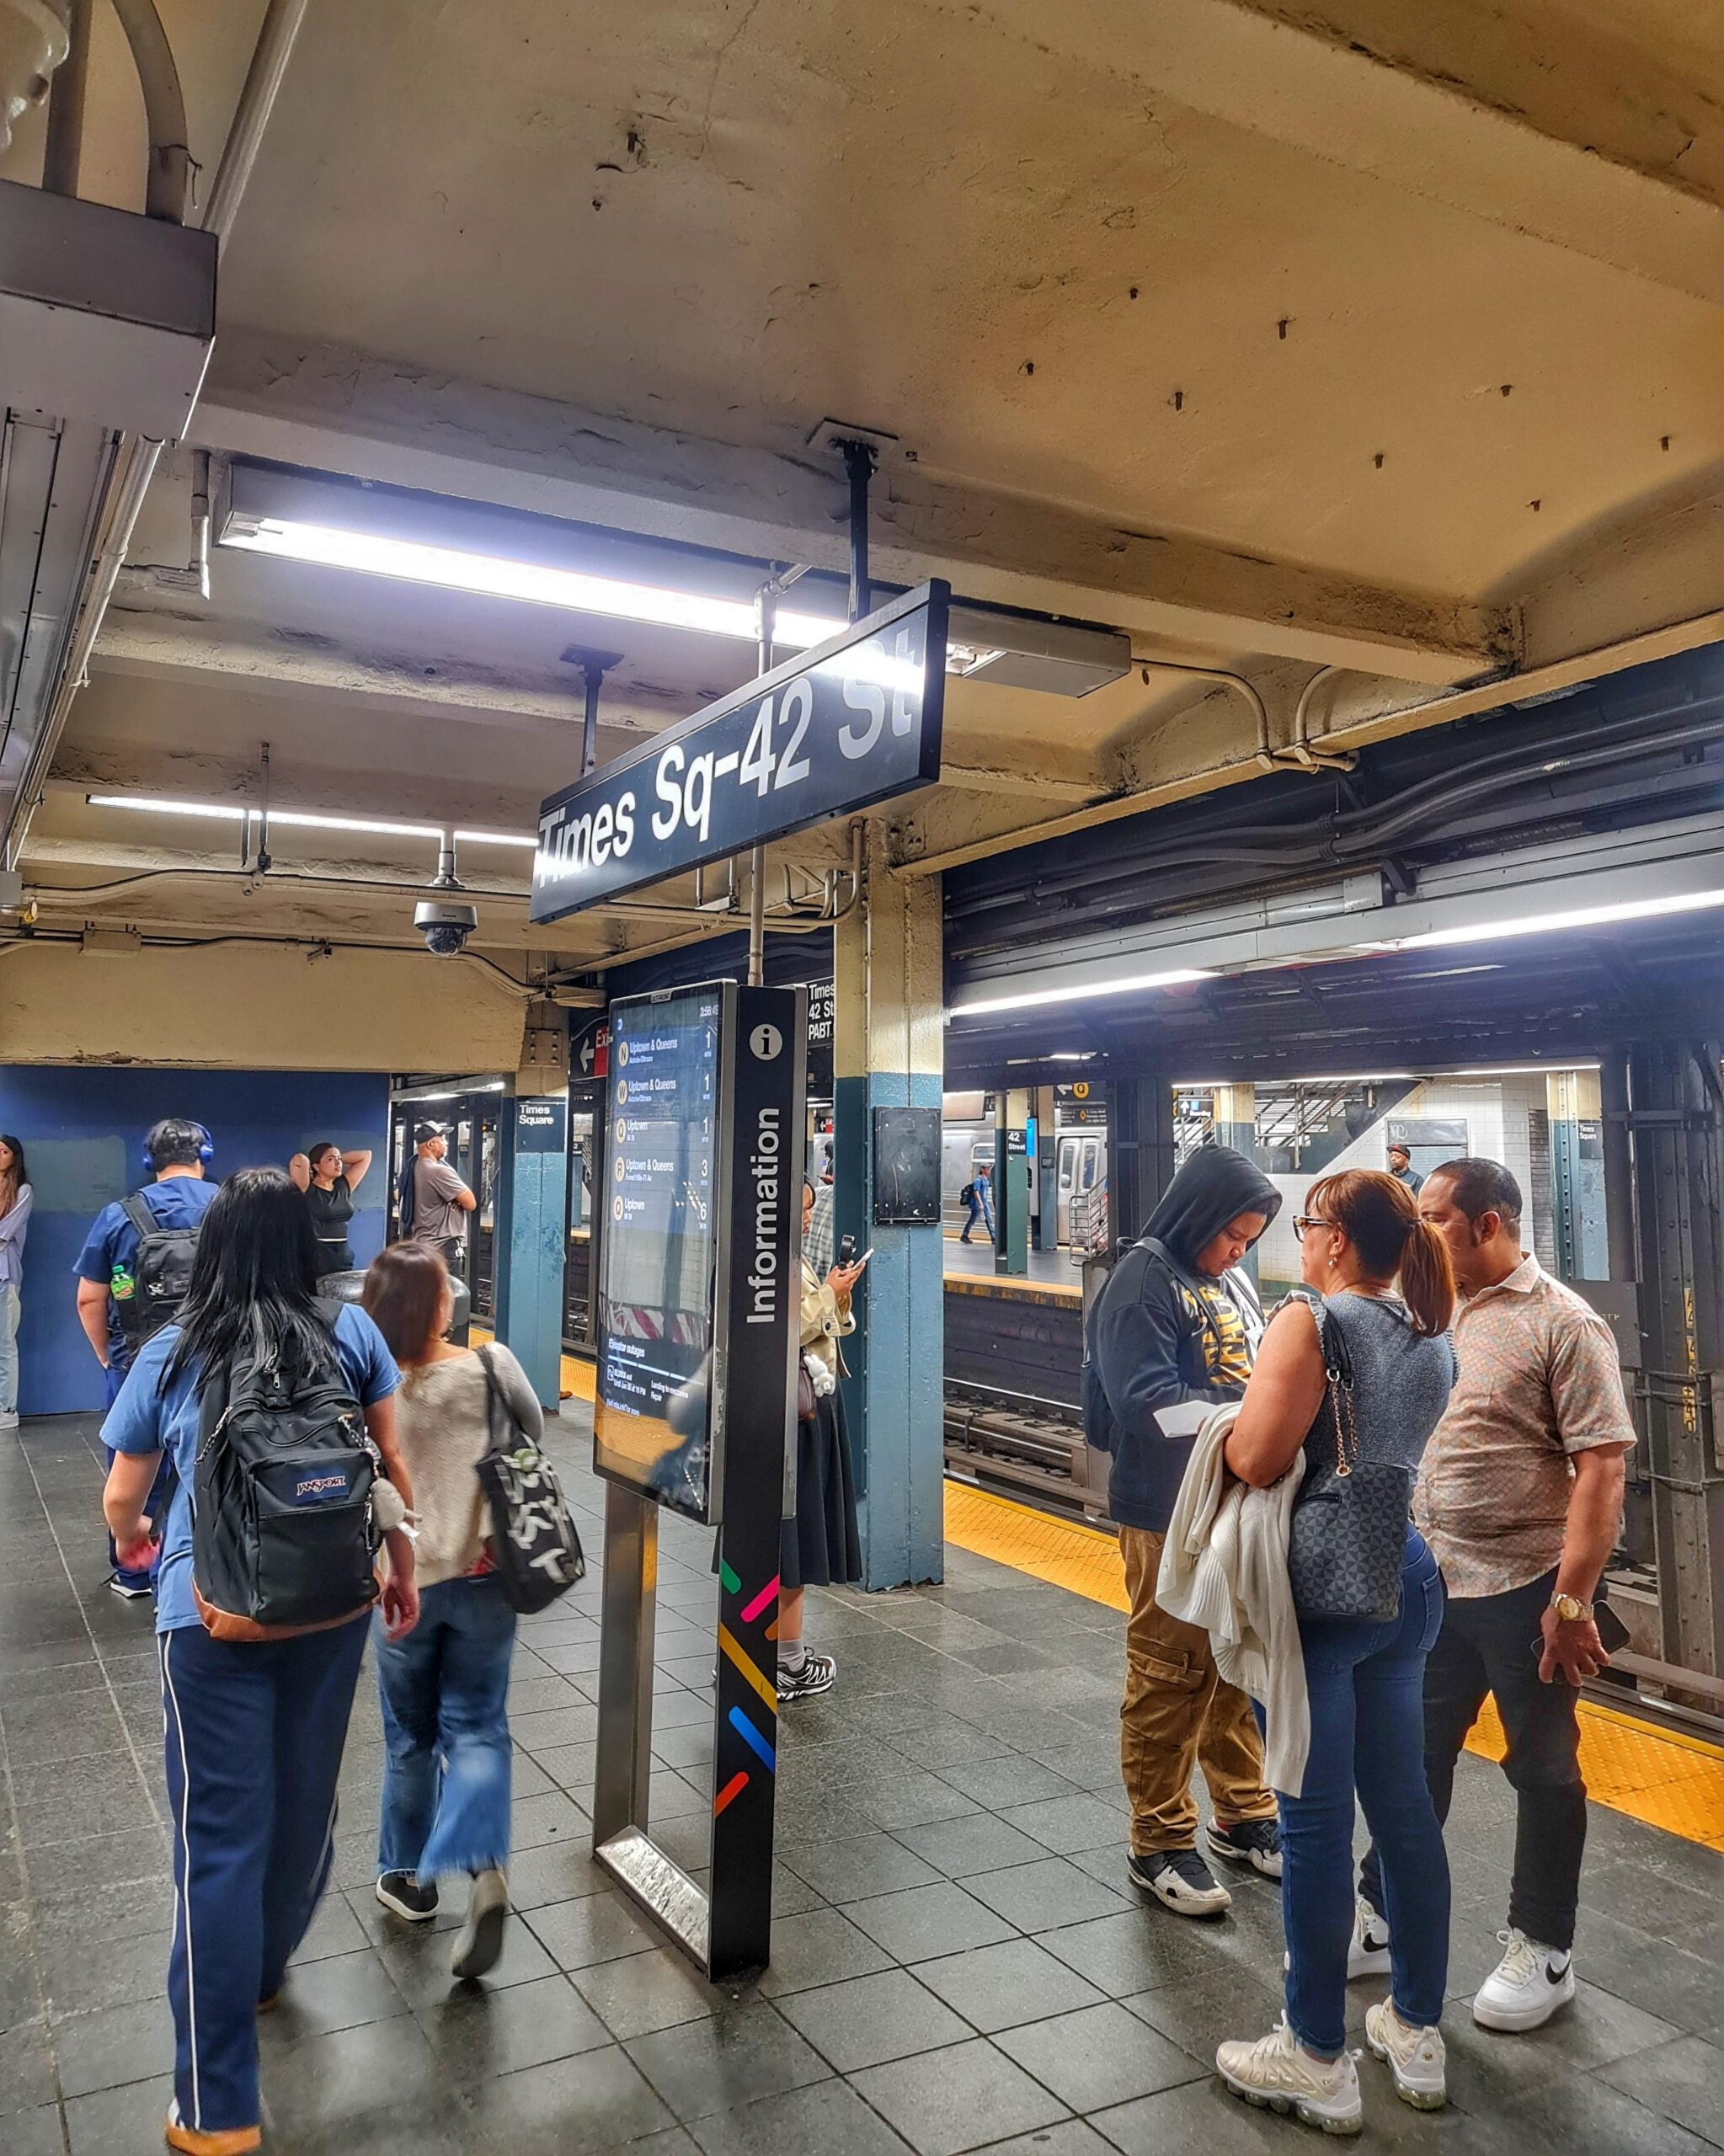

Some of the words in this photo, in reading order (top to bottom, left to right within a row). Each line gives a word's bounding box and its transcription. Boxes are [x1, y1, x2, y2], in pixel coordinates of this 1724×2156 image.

[538, 791, 636, 889] Times
[651, 677, 813, 842] Sq-42
[838, 627, 915, 760] St
[809, 984, 834, 1001] Times
[809, 1002, 821, 1020] 42
[595, 1027, 609, 1048] Exi
[809, 1021, 832, 1041] PABT
[629, 1042, 650, 1055] Uptown
[651, 1039, 656, 1051] &
[656, 1038, 677, 1050] Queens
[706, 1031, 711, 1049] 1
[628, 1081, 649, 1094] Uptown
[649, 1079, 654, 1091] &
[654, 1079, 676, 1090] Queens
[705, 1074, 709, 1091] 1
[519, 1104, 550, 1114] Times
[519, 1114, 554, 1126] Square
[627, 1120, 648, 1134] Uptown
[703, 1117, 708, 1134] 1
[1008, 1133, 1020, 1142] 42
[1579, 1132, 1597, 1140] Square
[626, 1159, 646, 1172] Uptown
[647, 1159, 652, 1171] &
[652, 1159, 674, 1171] Queens
[702, 1159, 707, 1177] 3
[624, 1198, 645, 1211] Uptown
[701, 1202, 707, 1220] 6
[746, 1107, 780, 1323] Information
[626, 1345, 645, 1358] outages
[296, 1476, 347, 1497] JANSPORT
